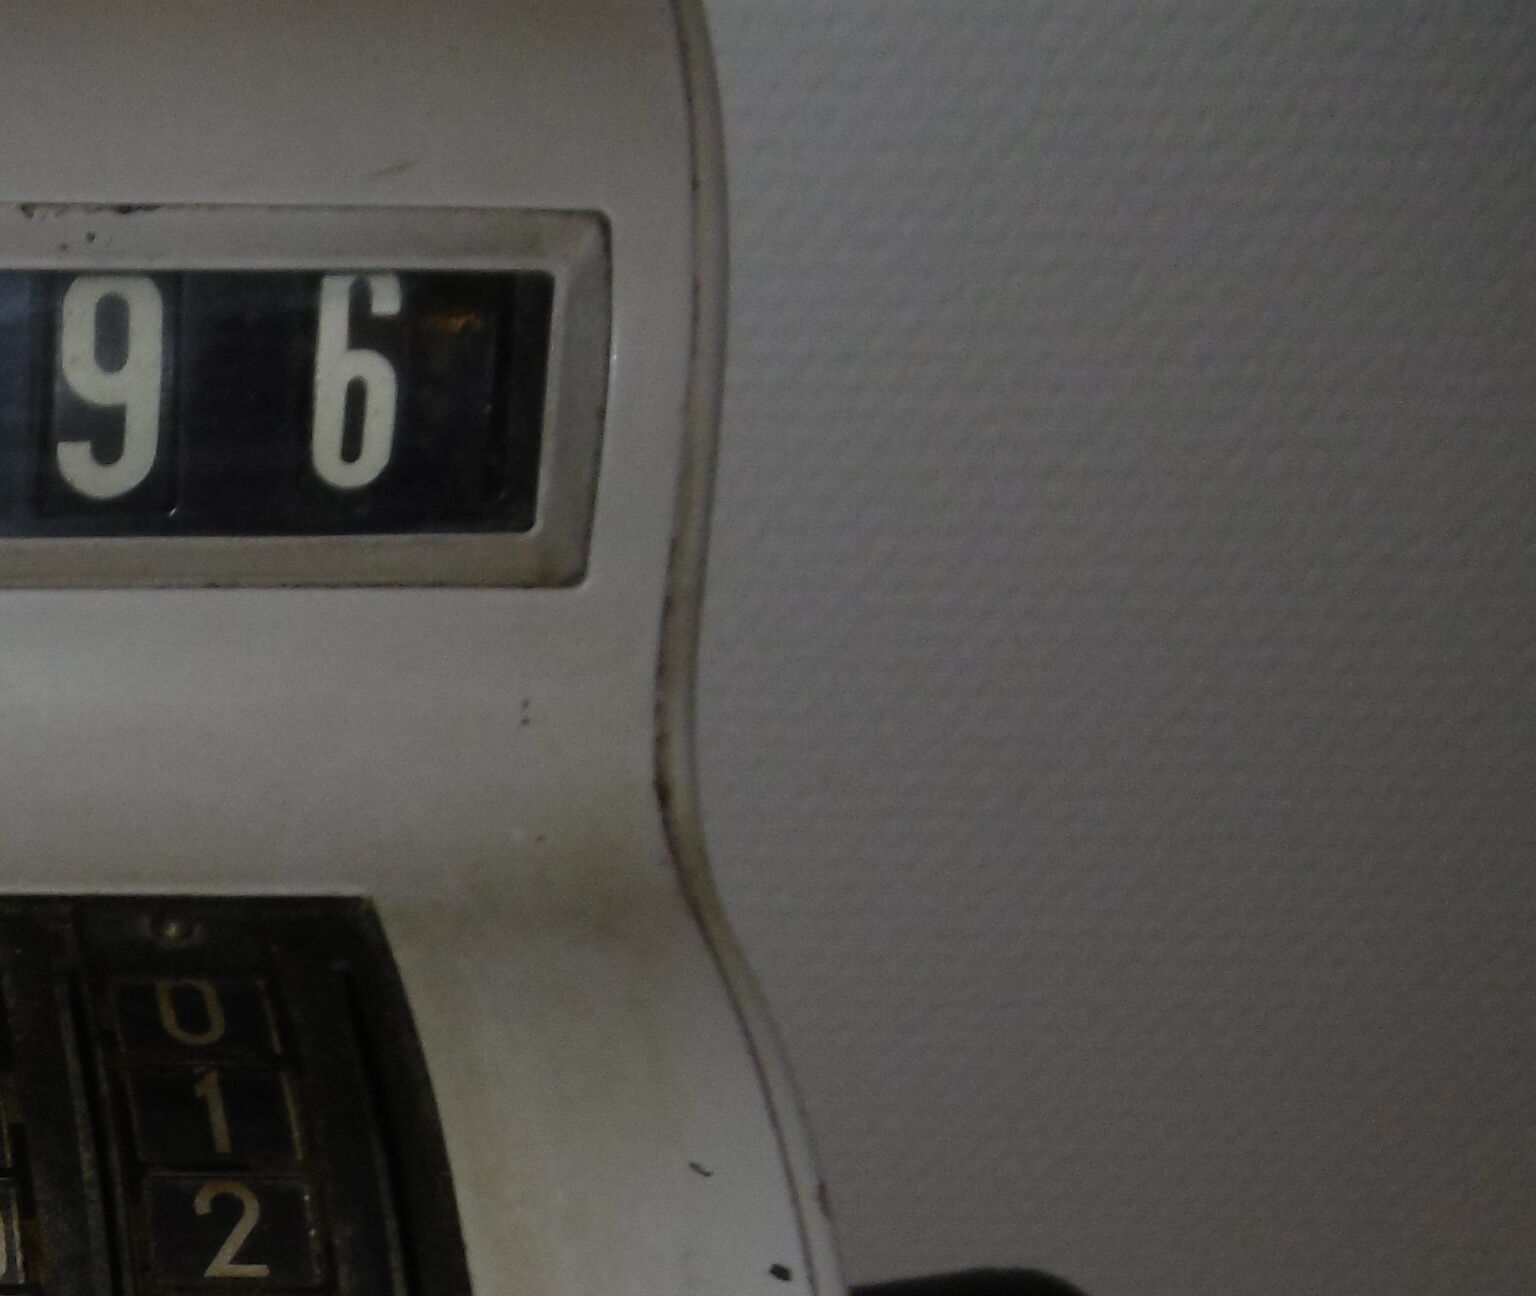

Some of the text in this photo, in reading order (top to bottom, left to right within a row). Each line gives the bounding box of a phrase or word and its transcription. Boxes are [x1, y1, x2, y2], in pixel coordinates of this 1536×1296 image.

[158, 979, 226, 1046] 0
[192, 1071, 232, 1155] 1
[192, 1182, 270, 1279] 2
